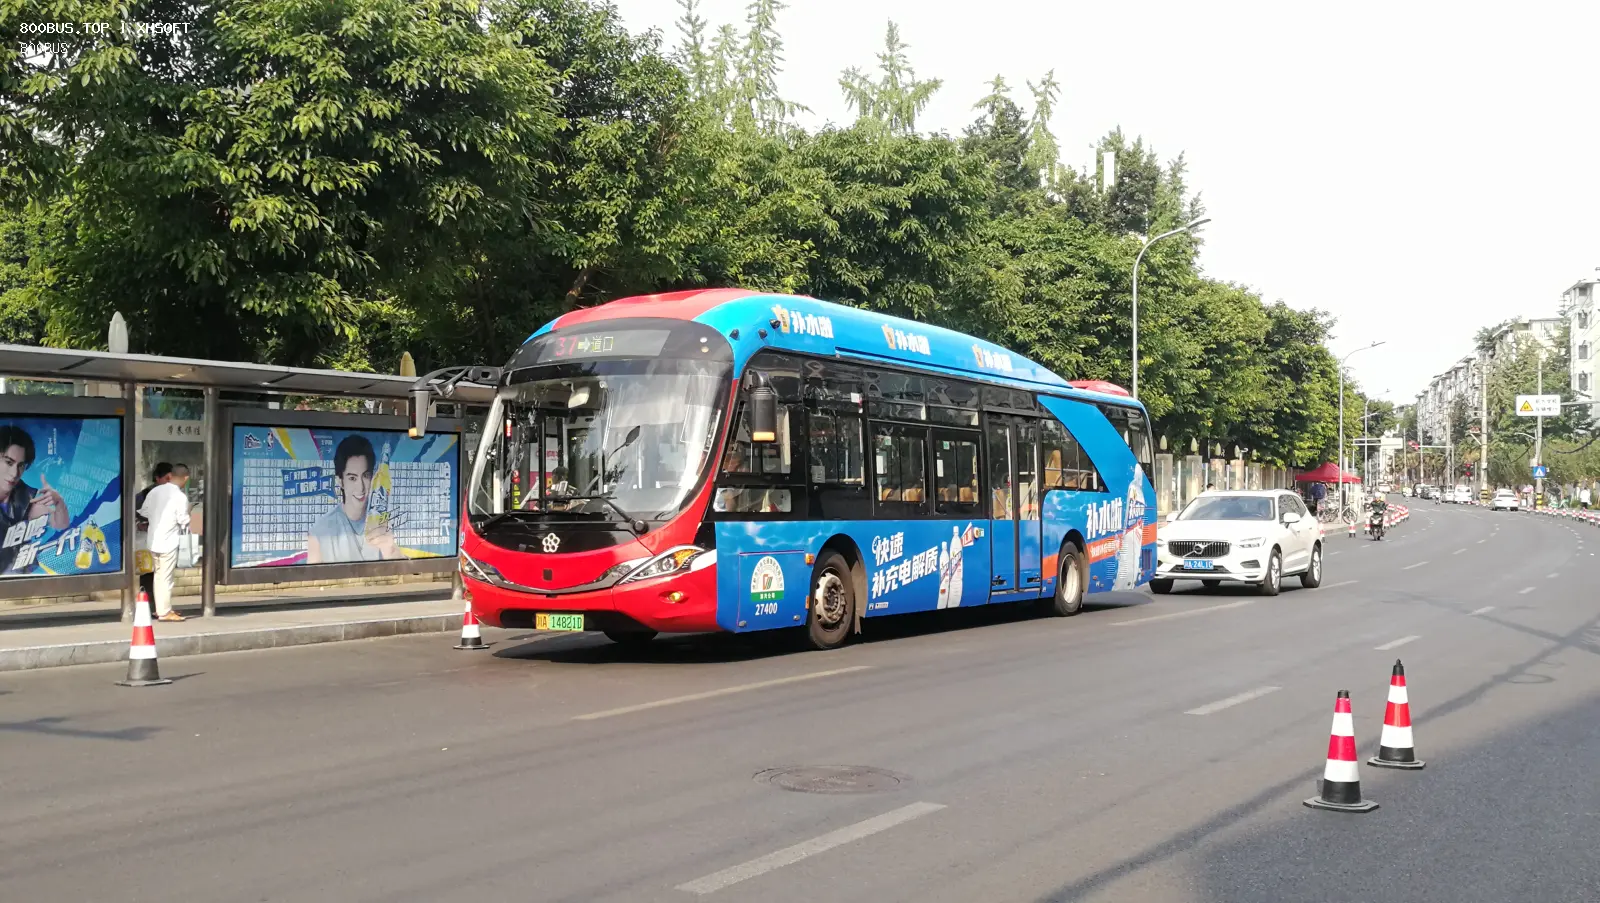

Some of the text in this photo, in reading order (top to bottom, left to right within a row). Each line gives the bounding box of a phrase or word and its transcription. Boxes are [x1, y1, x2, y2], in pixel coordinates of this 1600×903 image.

[2, 514, 49, 548] 哈啤
[12, 527, 81, 570] 新一代
[873, 531, 904, 567] 快速
[871, 545, 938, 599] 补充电解质
[755, 602, 778, 616] 27400
